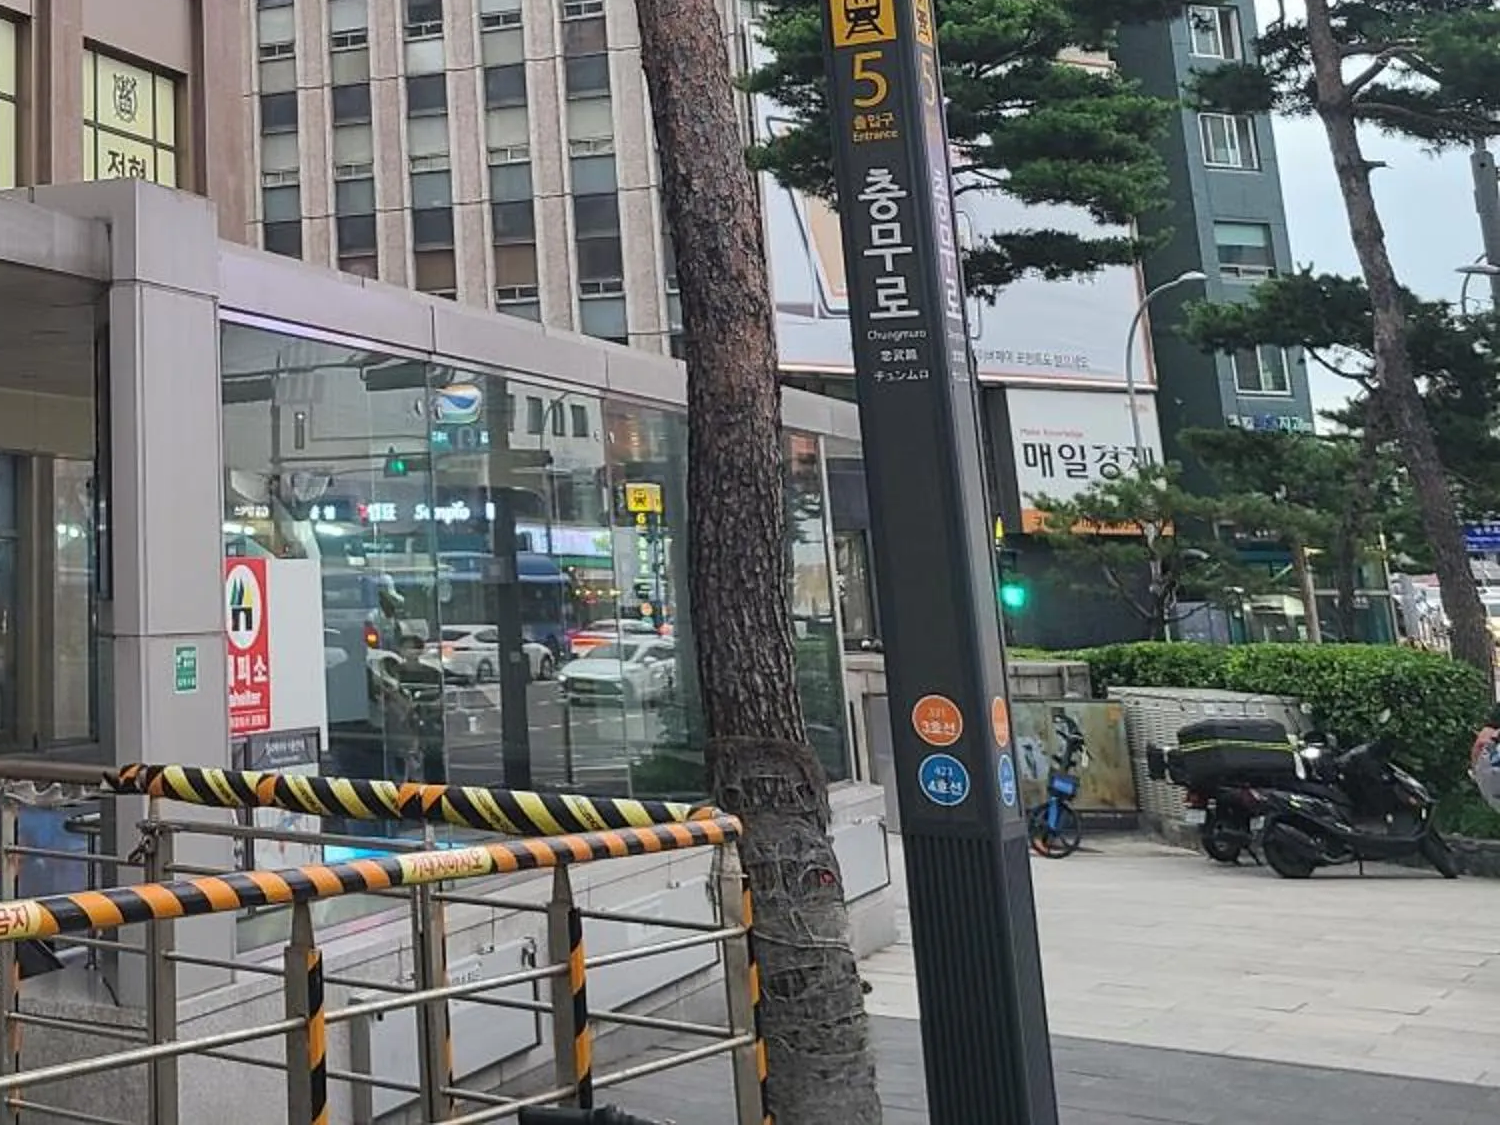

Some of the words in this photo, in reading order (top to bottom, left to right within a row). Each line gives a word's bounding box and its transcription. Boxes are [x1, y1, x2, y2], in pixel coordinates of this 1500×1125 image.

[852, 50, 889, 108] 5
[920, 54, 936, 107] 5
[853, 113, 894, 129] 출입구
[853, 129, 898, 143] Entrance
[857, 169, 920, 319] 충무로
[867, 328, 927, 341] Chungmuro
[927, 779, 963, 796] 4호선
